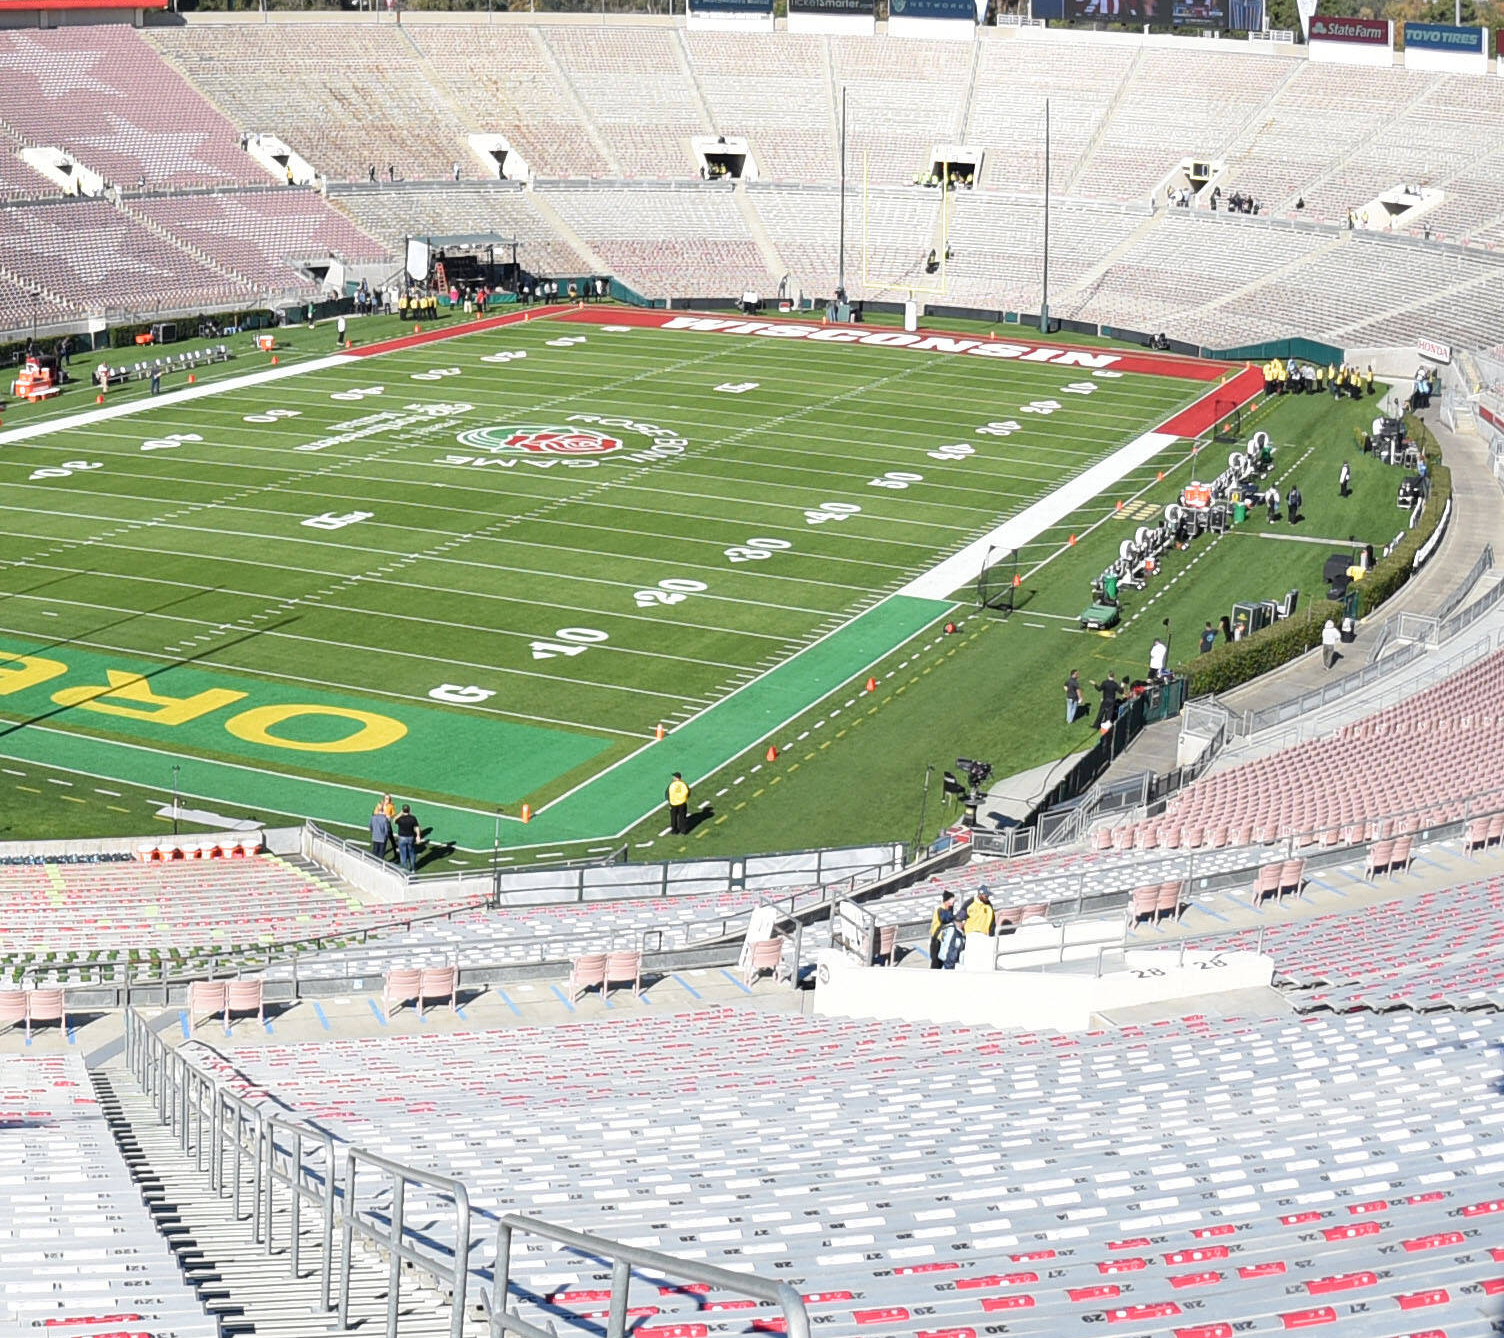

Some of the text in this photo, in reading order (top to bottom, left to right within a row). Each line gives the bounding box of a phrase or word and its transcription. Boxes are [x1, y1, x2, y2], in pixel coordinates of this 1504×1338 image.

[1442, 32, 1479, 45] TIRES
[661, 317, 1121, 367] WISCONSIN
[242, 410, 302, 423] 50
[927, 444, 975, 460] 40
[37, 461, 105, 479] 30
[433, 455, 600, 468] GAME
[867, 472, 924, 489] 50
[803, 502, 862, 524] 40
[724, 538, 792, 560] 30
[637, 579, 709, 606] 20
[530, 627, 610, 657] 10
[428, 683, 498, 703] G
[1130, 967, 1166, 978] 28
